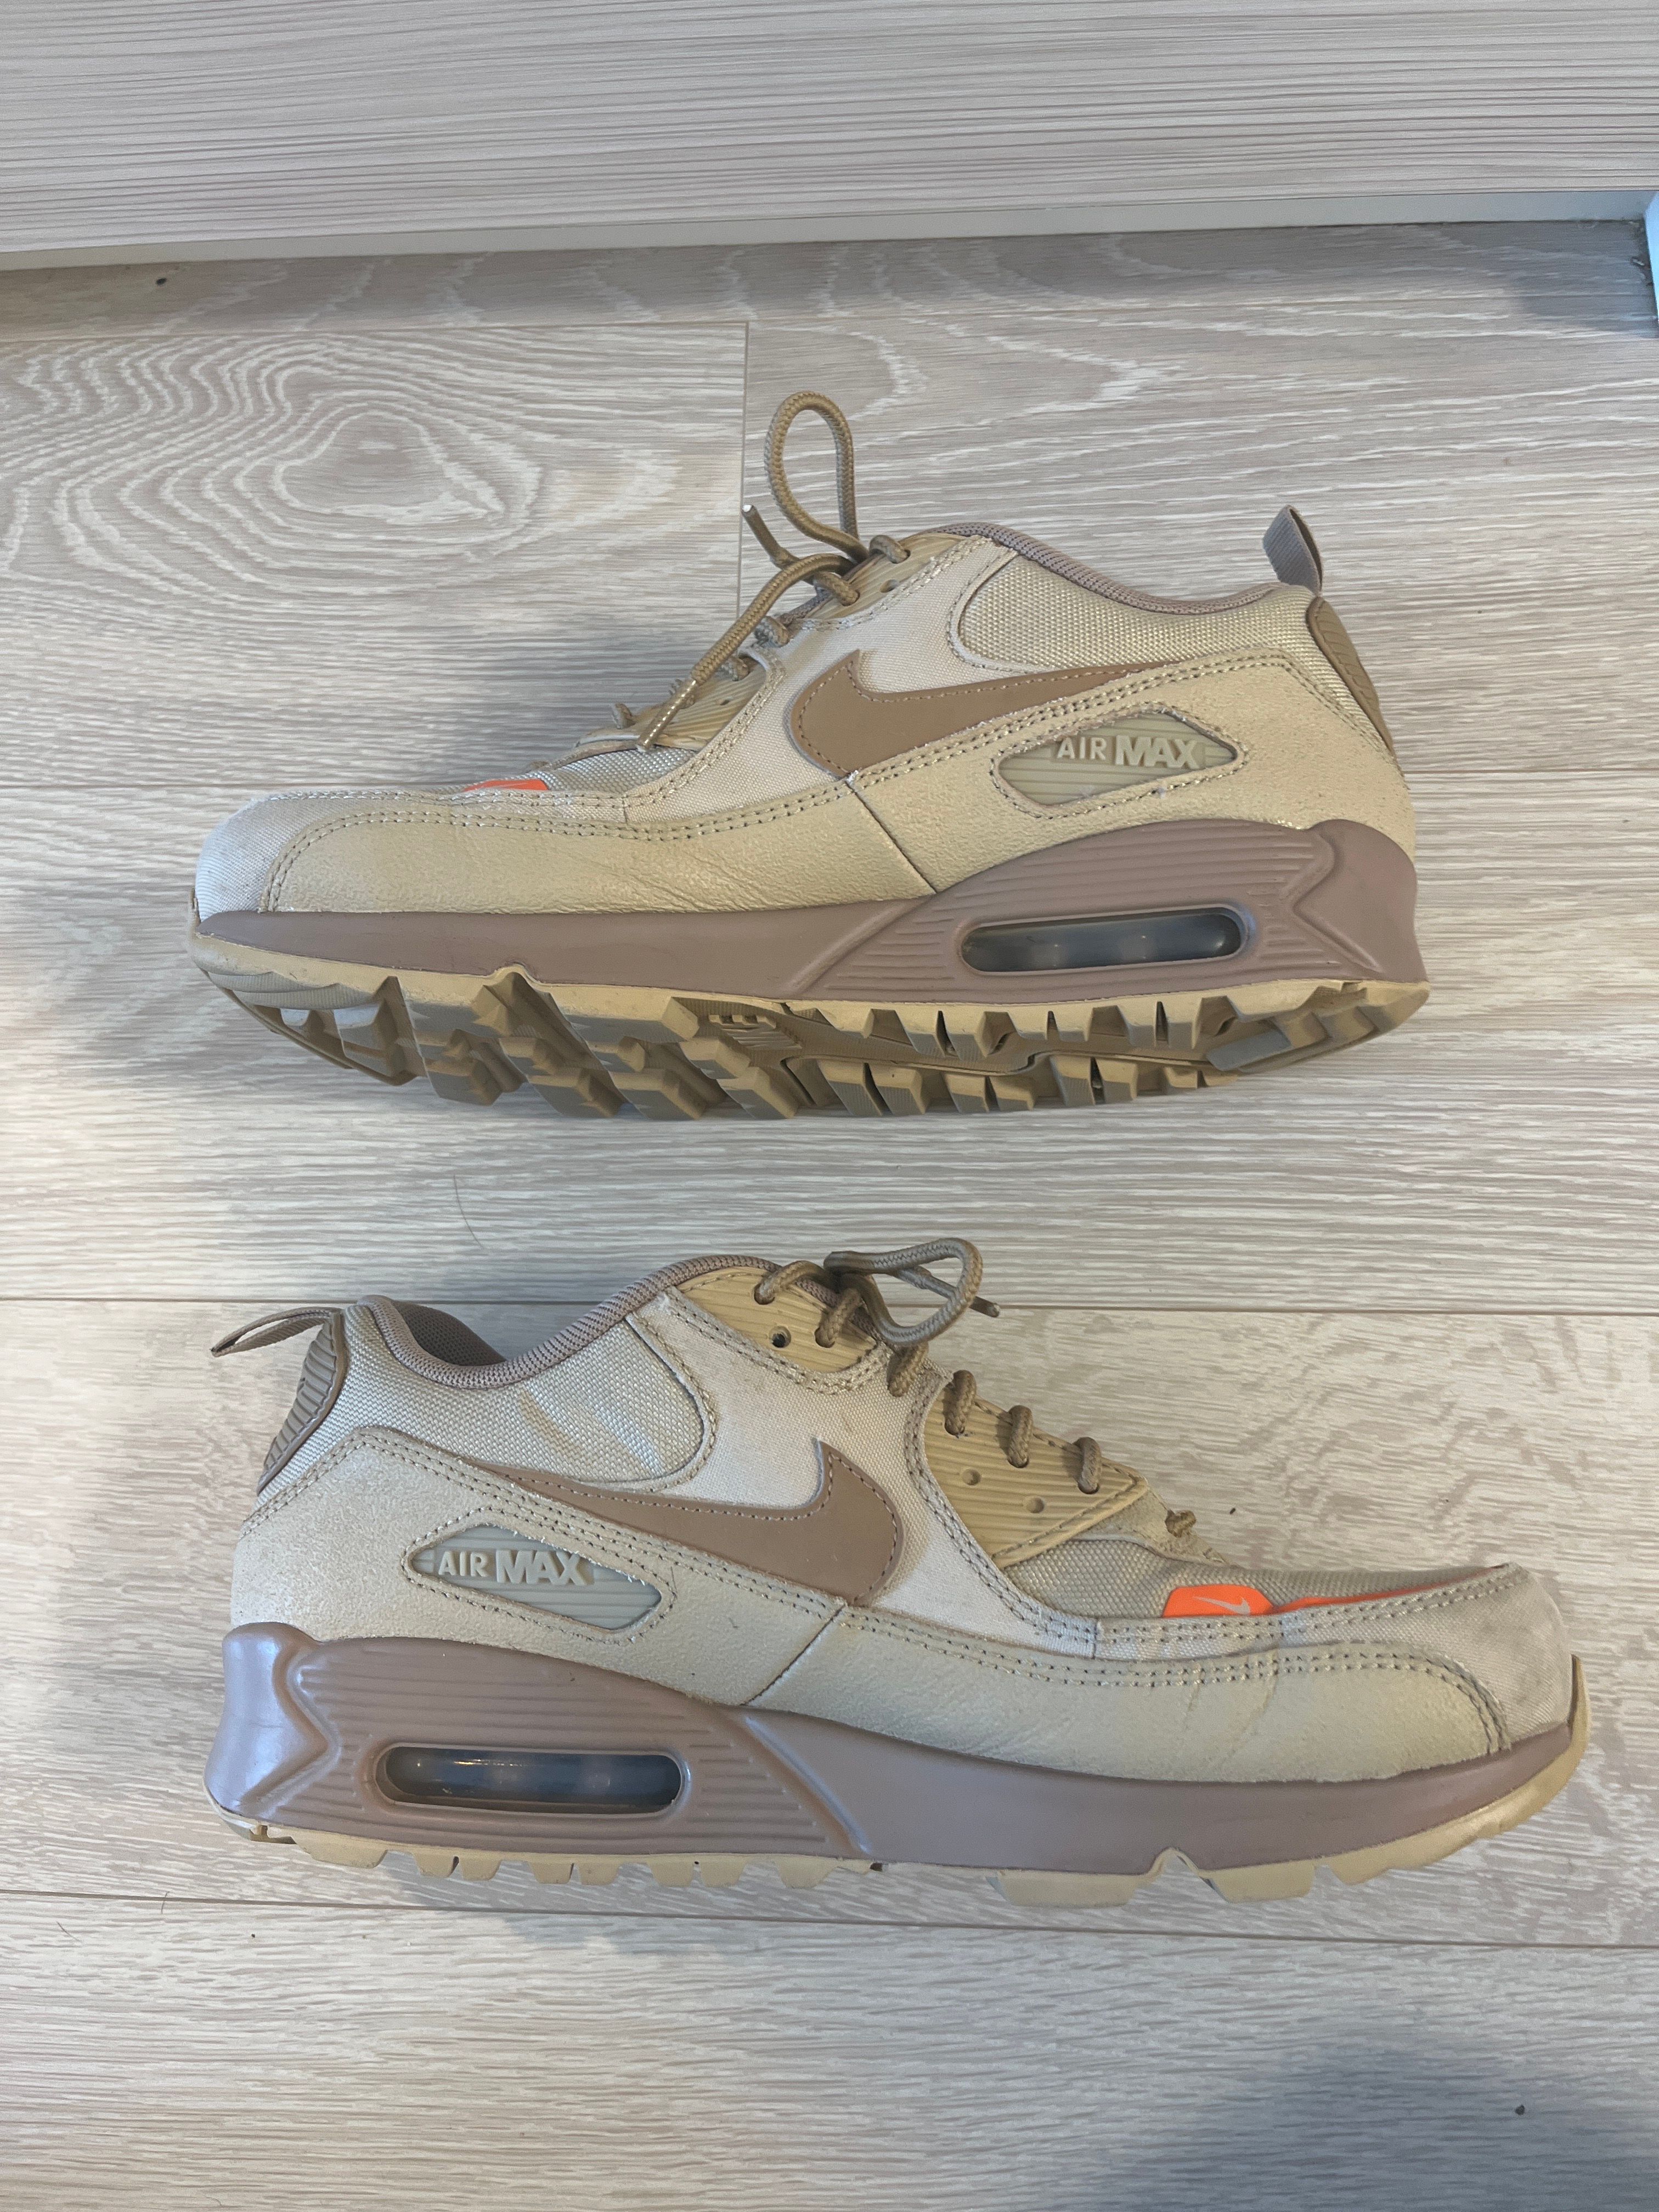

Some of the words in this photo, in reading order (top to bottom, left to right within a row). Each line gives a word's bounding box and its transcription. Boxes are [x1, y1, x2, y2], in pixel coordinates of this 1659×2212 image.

[1057, 737, 1107, 760] AIR
[1115, 735, 1200, 768] MAX
[438, 1550, 488, 1577] AIR
[495, 1549, 588, 1585] MAX
